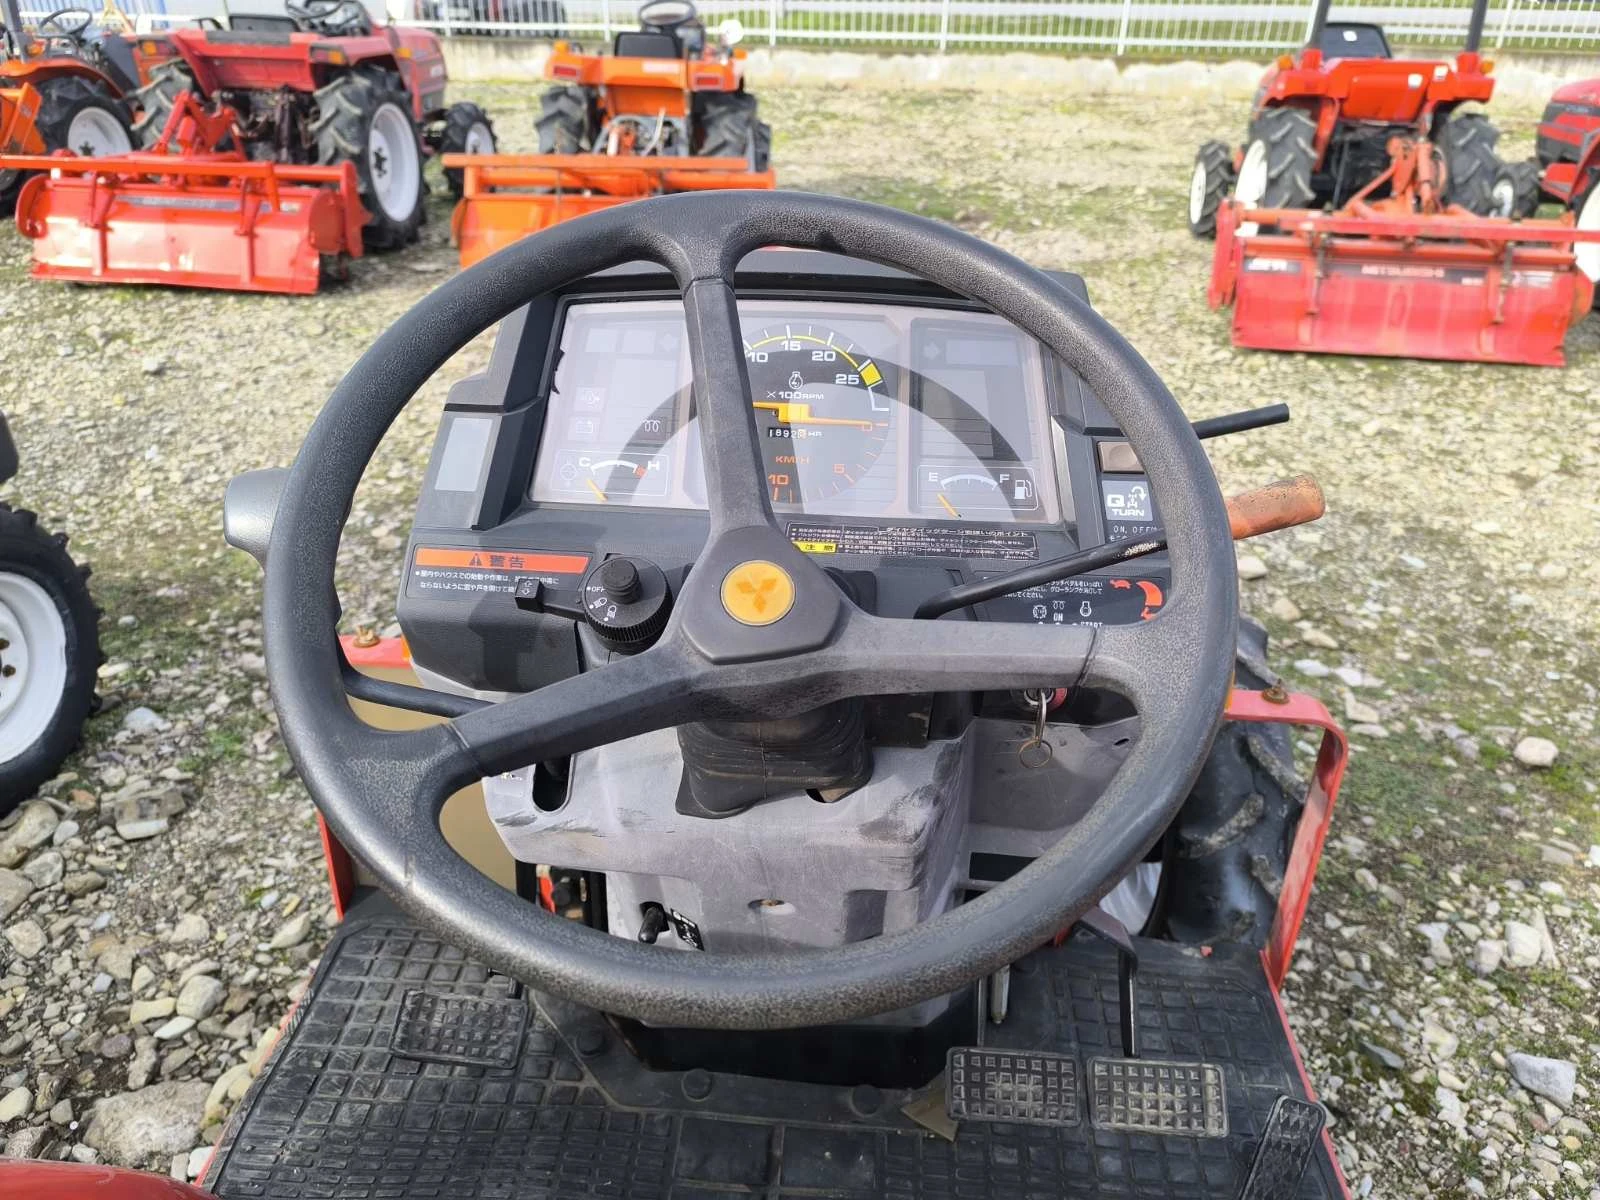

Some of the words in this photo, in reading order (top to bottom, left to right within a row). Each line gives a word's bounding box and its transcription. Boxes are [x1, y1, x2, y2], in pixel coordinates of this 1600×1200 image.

[781, 340, 801, 351] 15
[749, 352, 768, 363] 10
[812, 350, 836, 362] 20
[835, 373, 860, 385] 25
[578, 456, 591, 467] C
[647, 460, 660, 471] H
[768, 474, 789, 485] 10
[928, 471, 939, 482] E
[999, 473, 1010, 483] F
[1107, 494, 1125, 507] Q
[1112, 508, 1145, 517] TURN
[490, 554, 526, 569] 警告
[1053, 612, 1064, 622] ON
